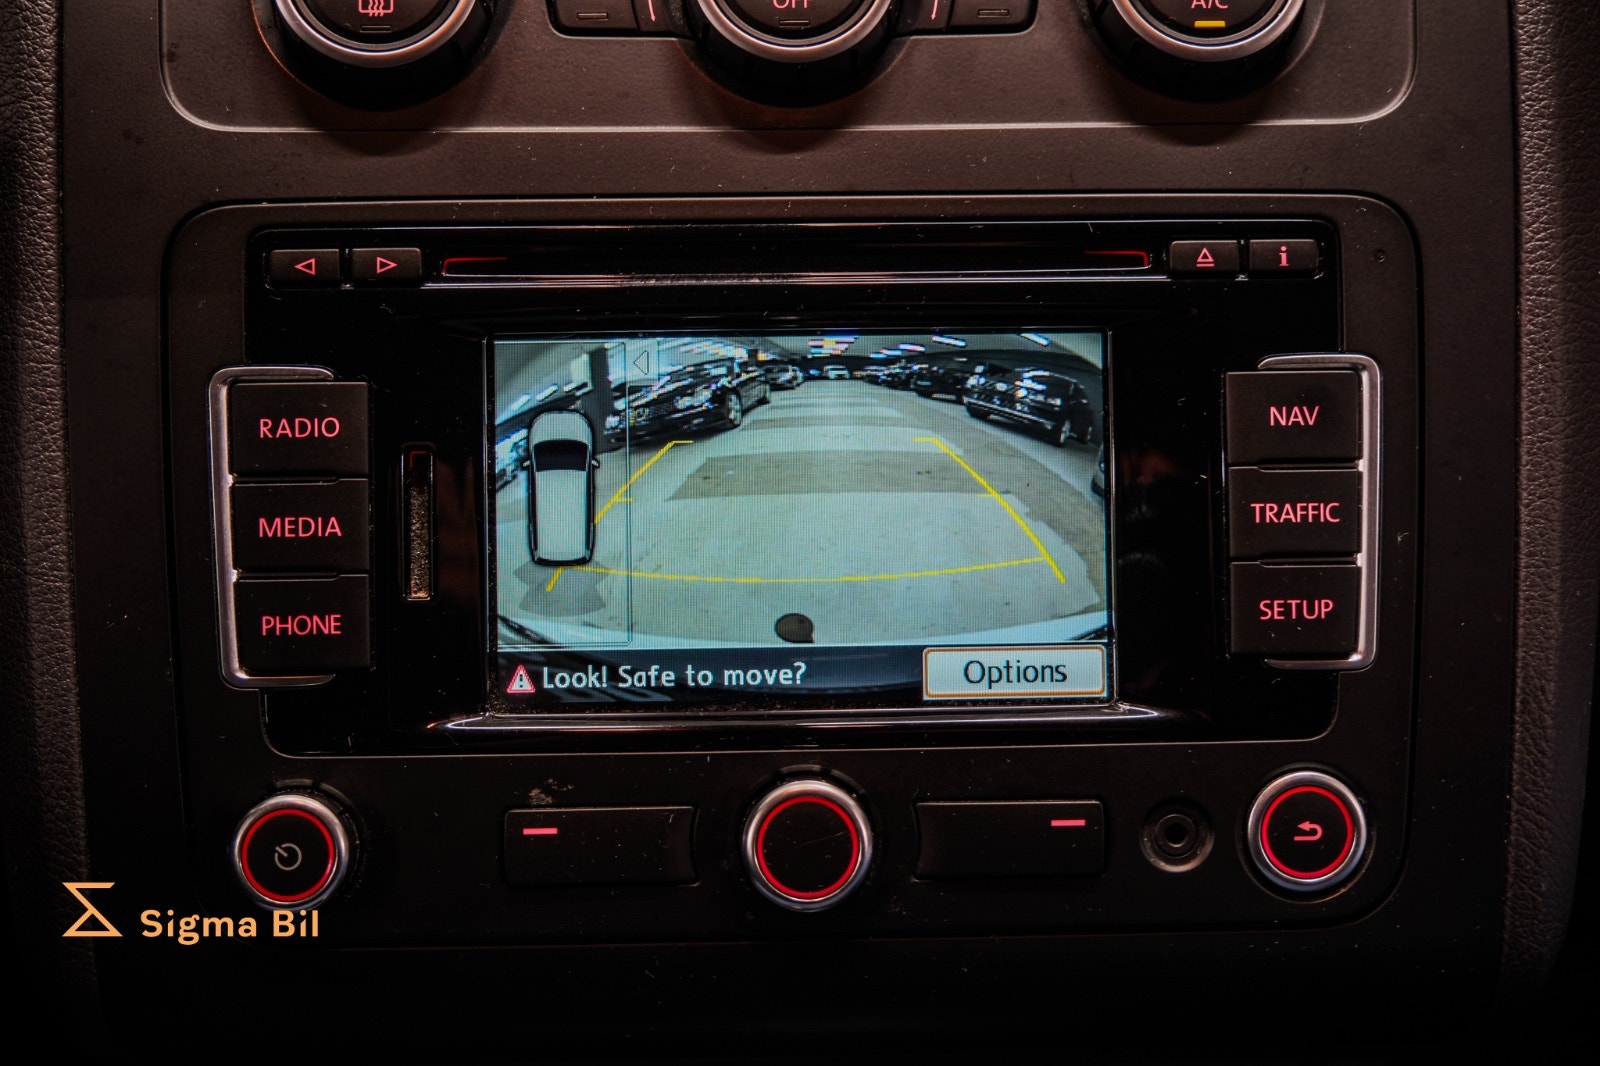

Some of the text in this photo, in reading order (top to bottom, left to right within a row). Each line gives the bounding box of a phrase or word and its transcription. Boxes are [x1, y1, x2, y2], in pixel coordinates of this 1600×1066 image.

[1279, 245, 1290, 267] i
[259, 416, 340, 438] RADIO
[1269, 406, 1320, 426] NAV
[1251, 502, 1341, 523] TRAFFIC
[258, 516, 342, 538] MEDIA
[1259, 600, 1334, 620] SETUP
[261, 614, 342, 636] PHONE
[542, 662, 806, 689] Look! Safe to move?
[963, 658, 1068, 688] Options
